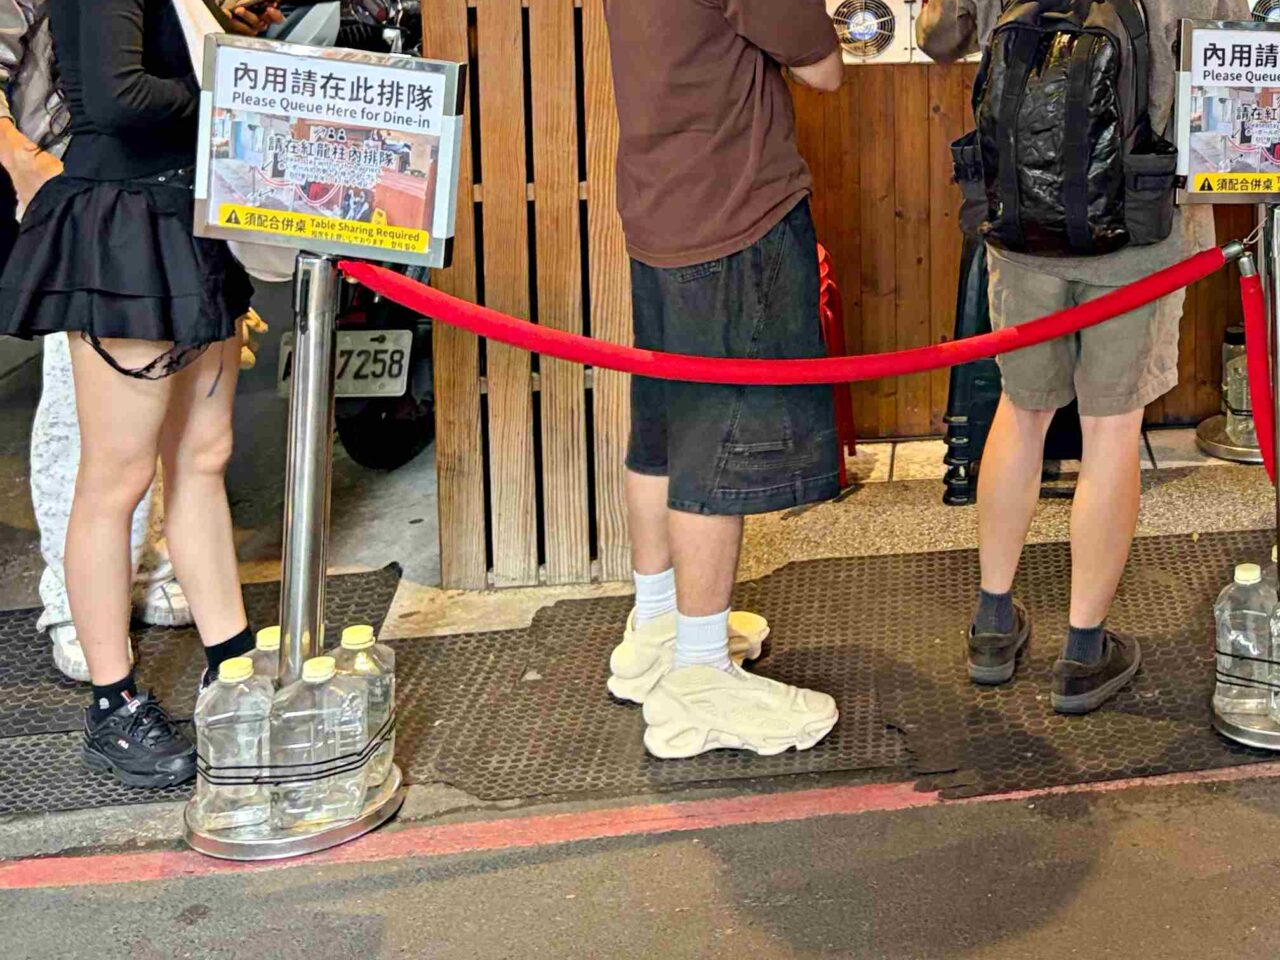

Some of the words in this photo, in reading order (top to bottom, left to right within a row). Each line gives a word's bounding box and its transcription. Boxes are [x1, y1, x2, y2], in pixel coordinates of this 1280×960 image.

[234, 62, 433, 113] 內用請在此排隊
[1203, 70, 1242, 82] Please
[232, 91, 277, 109] Please
[280, 97, 323, 116] Queue
[326, 103, 357, 120] Here
[361, 107, 381, 122] for
[383, 111, 431, 129] Dine-in
[1217, 178, 1274, 191] 須配合併桌
[244, 212, 307, 234] 須配合併桌
[310, 218, 336, 231] Table
[338, 222, 374, 238] Sharing
[376, 227, 420, 242] Required
